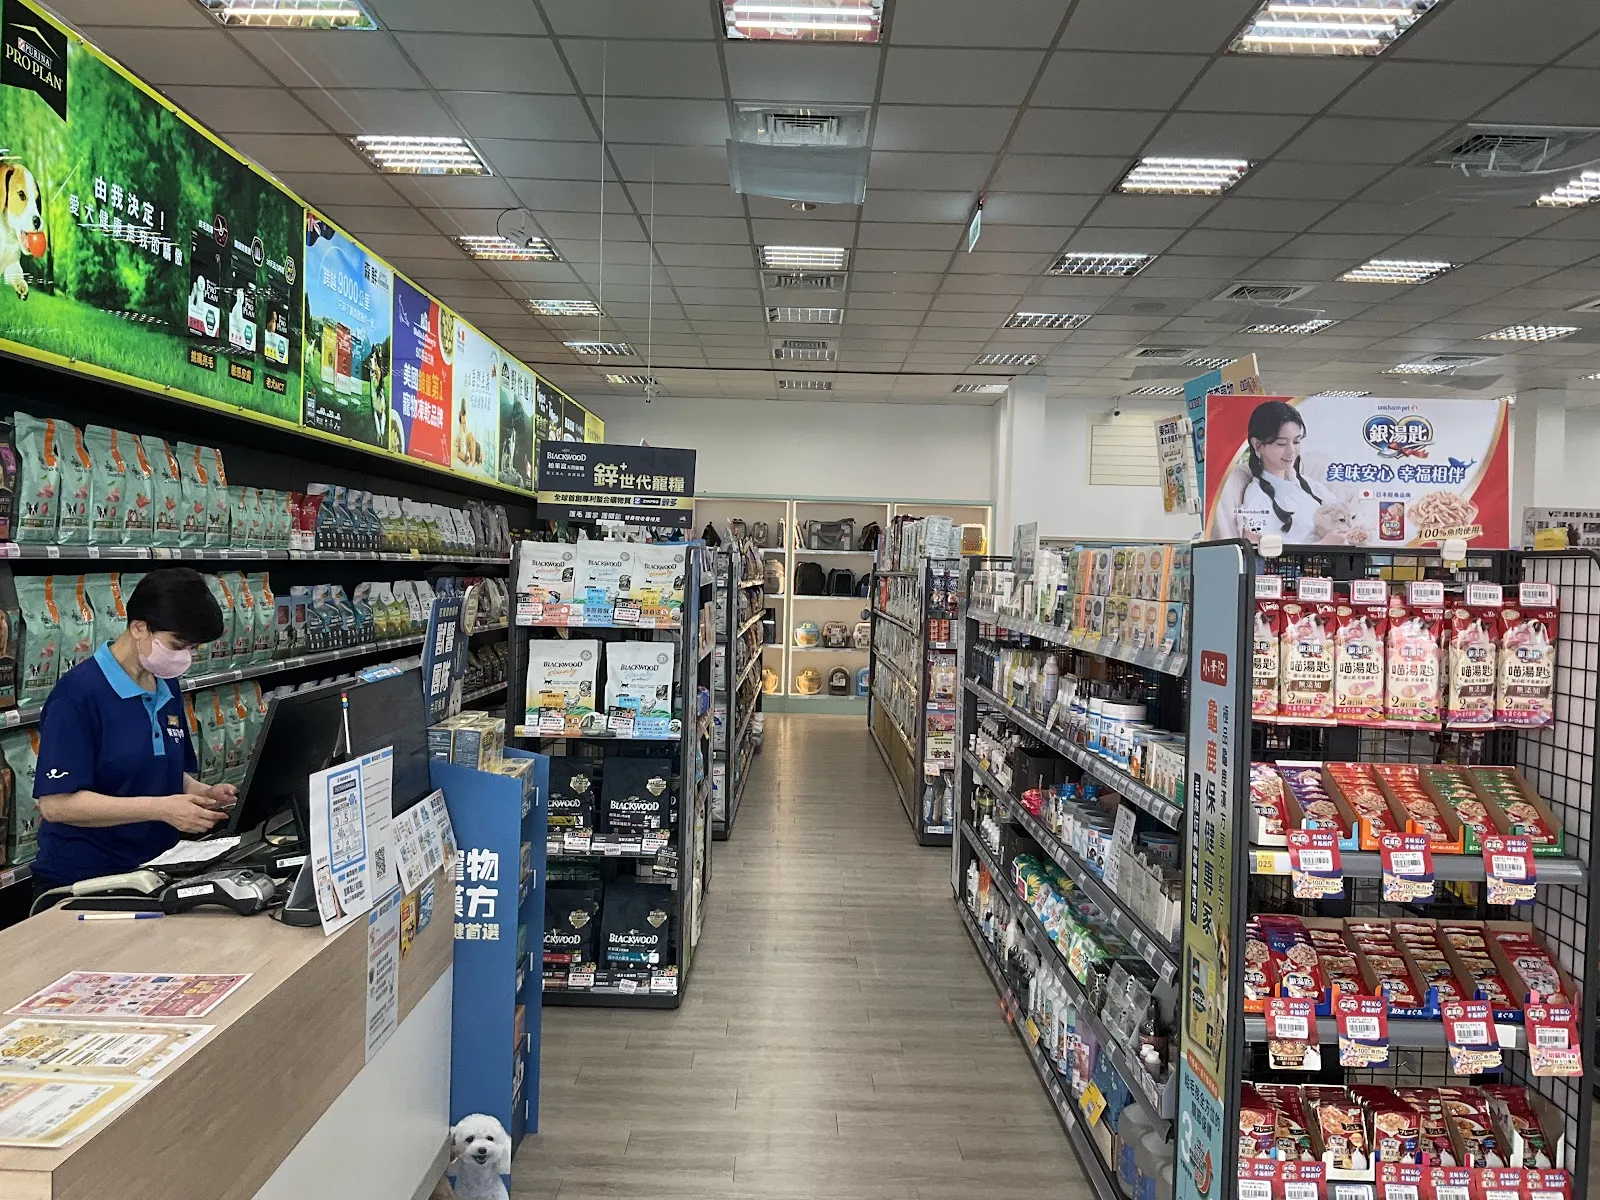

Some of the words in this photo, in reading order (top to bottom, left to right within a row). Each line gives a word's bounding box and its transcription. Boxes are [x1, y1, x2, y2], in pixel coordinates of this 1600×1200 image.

[24, 43, 51, 67] PURINA
[5, 44, 31, 71] PRO
[33, 65, 62, 92] PLAN
[1369, 424, 1428, 443] 銀湯匙
[547, 451, 587, 461] BLACKWOOD
[1327, 464, 1394, 484] 美味安心
[1398, 464, 1466, 483] 幸福相伴
[1418, 526, 1480, 539] 100%魚肉使用
[531, 559, 565, 567] BLACKWOOD
[588, 559, 622, 568] BLACKWOOD
[644, 562, 677, 570] BLACKWOOD
[620, 663, 659, 671] BLACKWOOD
[1290, 660, 1331, 673] 喵湯匙
[1340, 662, 1380, 674] 喵湯匙
[1391, 664, 1435, 676] 喵湯匙
[1461, 665, 1493, 677] 喵湯匙
[1508, 666, 1551, 679] 喵湯匙
[1298, 680, 1322, 689] 無添加
[1468, 685, 1487, 693] 無添加
[547, 798, 581, 808] CKWOOD
[610, 800, 660, 811] BLACKWOOD
[1258, 860, 1273, 868] 025
[543, 933, 581, 944] CKWOOD
[609, 932, 659, 944] BLACKWOOD
